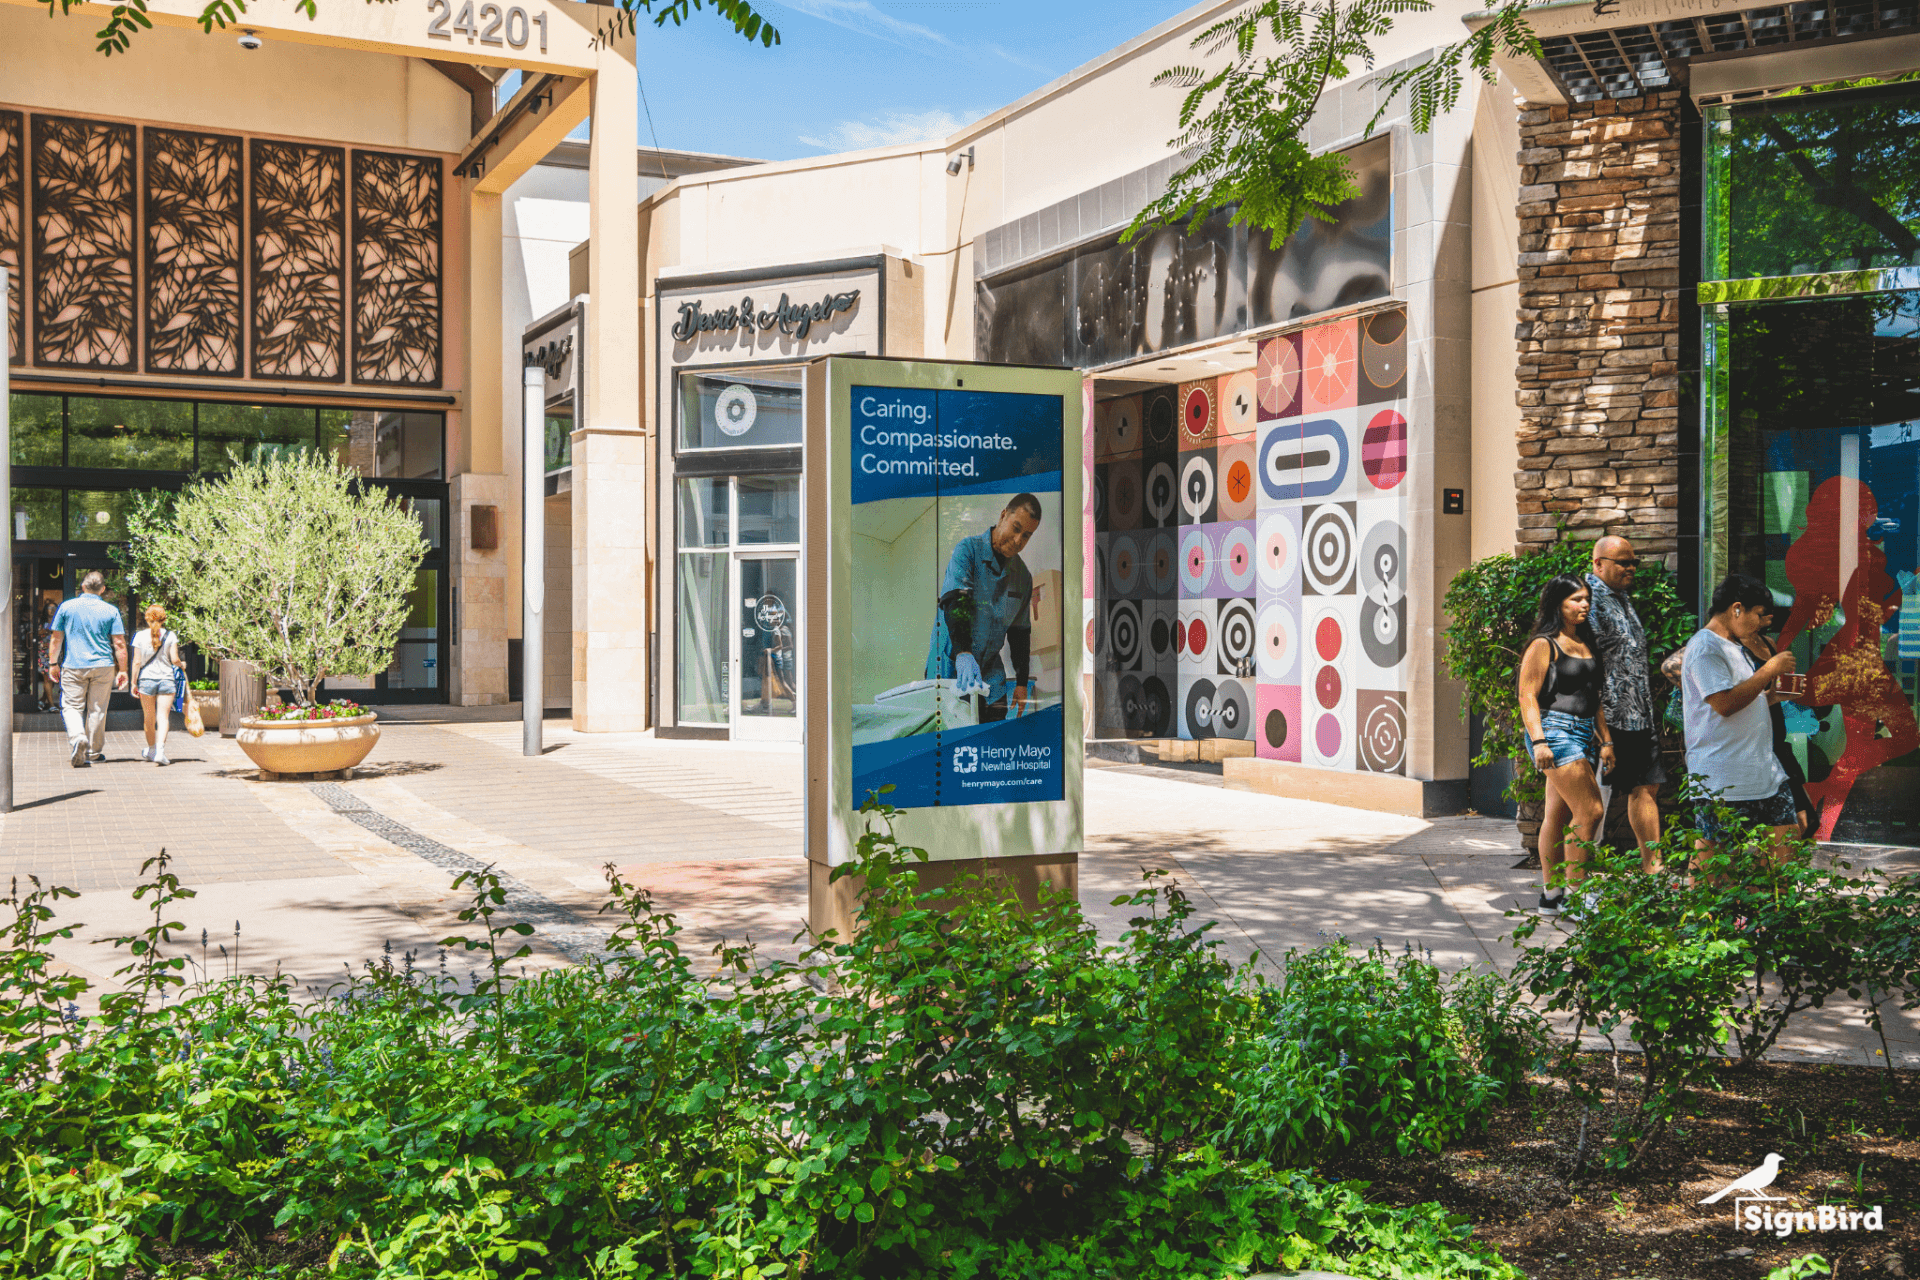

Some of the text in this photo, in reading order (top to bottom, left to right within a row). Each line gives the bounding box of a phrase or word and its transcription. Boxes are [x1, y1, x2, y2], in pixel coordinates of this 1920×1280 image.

[427, 0, 548, 50] 24201
[671, 292, 836, 341] Devil & Angel
[860, 396, 932, 424] Caring.
[860, 425, 1017, 453] Compassionate.
[860, 453, 980, 477] Committed.
[980, 744, 1051, 761] Henry Mayo
[980, 760, 1051, 772] Newhall Hospital
[961, 778, 1043, 788] henrymayo.com/care
